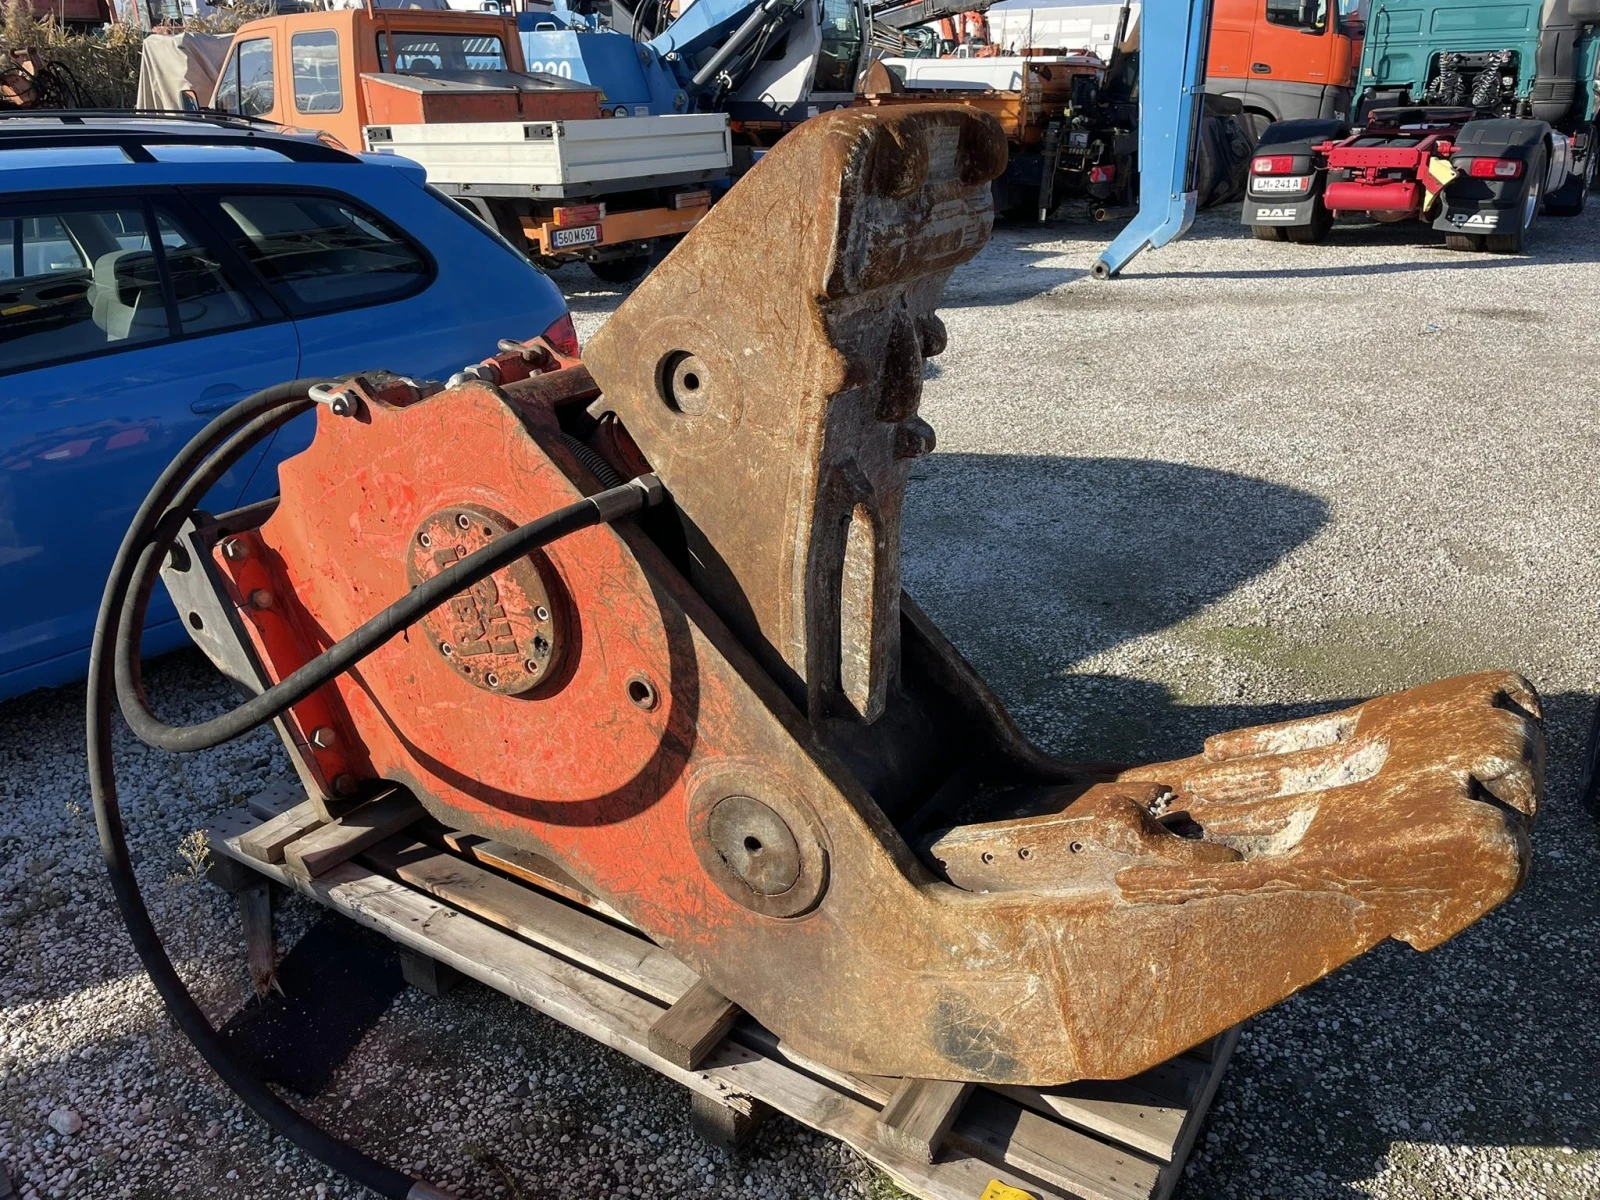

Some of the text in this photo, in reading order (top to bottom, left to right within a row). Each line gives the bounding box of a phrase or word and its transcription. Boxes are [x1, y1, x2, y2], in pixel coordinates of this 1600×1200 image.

[1256, 208, 1297, 217] DAF
[1452, 213, 1499, 224] DAF
[558, 228, 595, 244] 560M692
